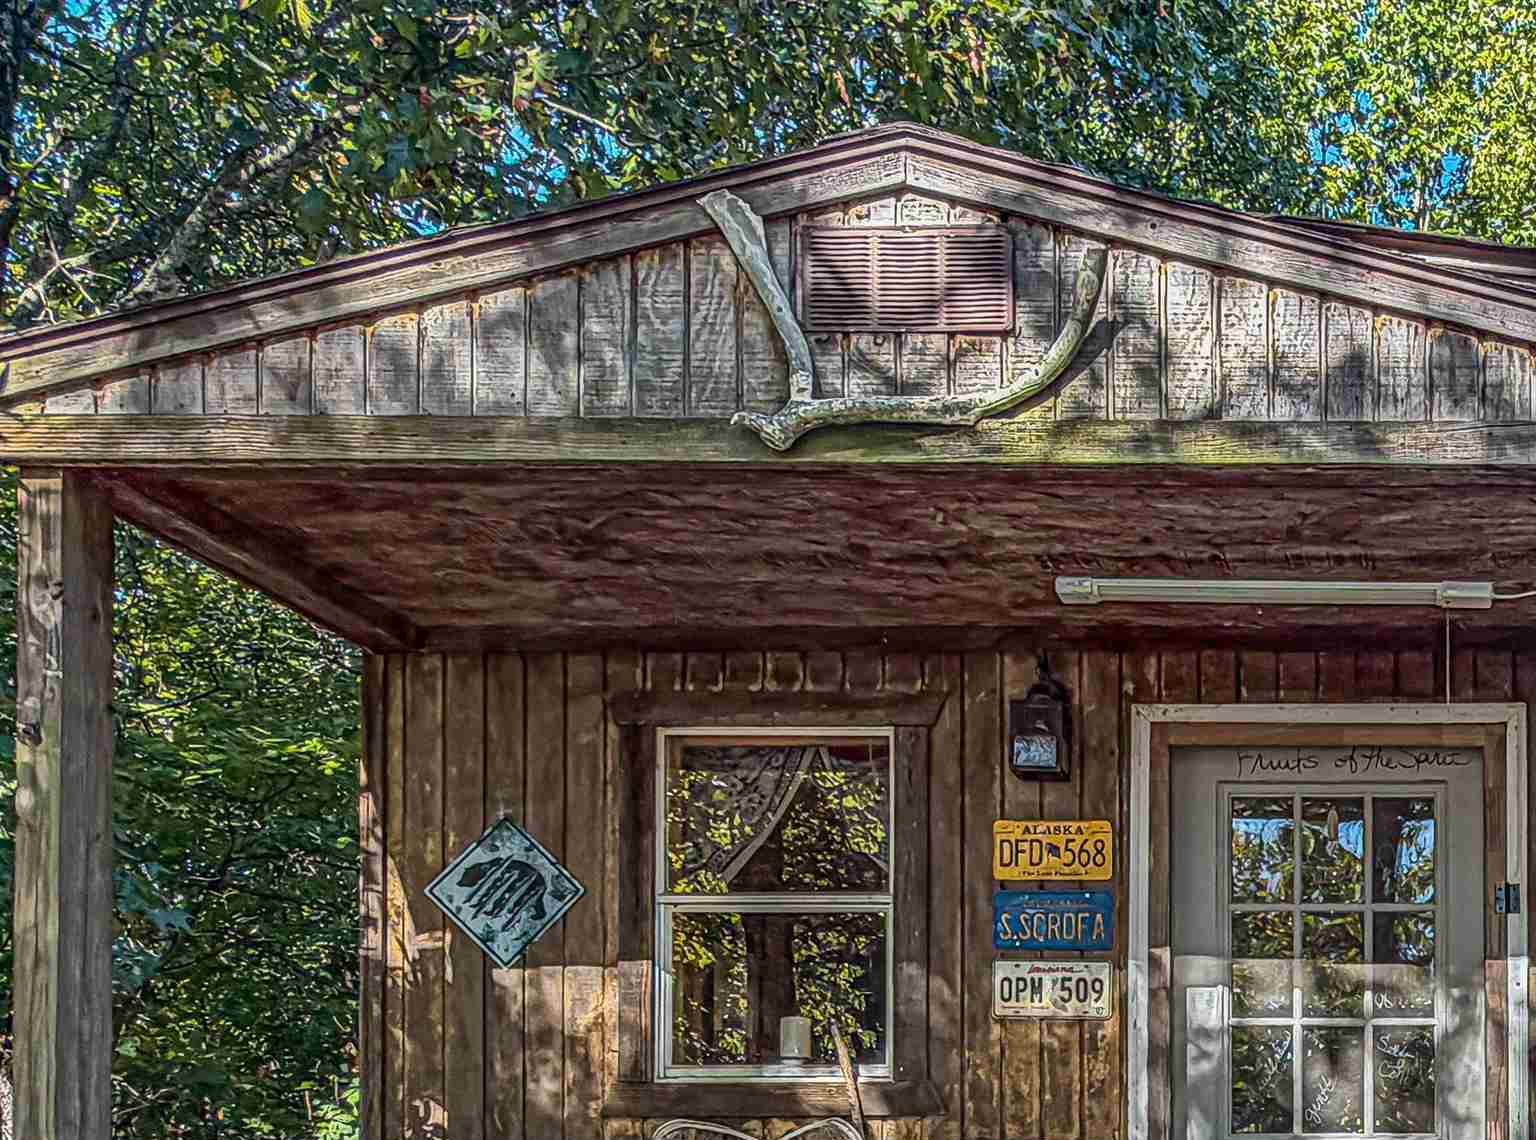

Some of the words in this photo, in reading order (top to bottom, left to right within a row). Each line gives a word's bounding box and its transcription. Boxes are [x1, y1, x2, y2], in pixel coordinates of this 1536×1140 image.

[1335, 745, 1358, 774] of
[1022, 824, 1084, 835] ALASKA
[999, 838, 1043, 867] DFD
[1063, 838, 1106, 868] 568
[1060, 976, 1104, 1003] 509
